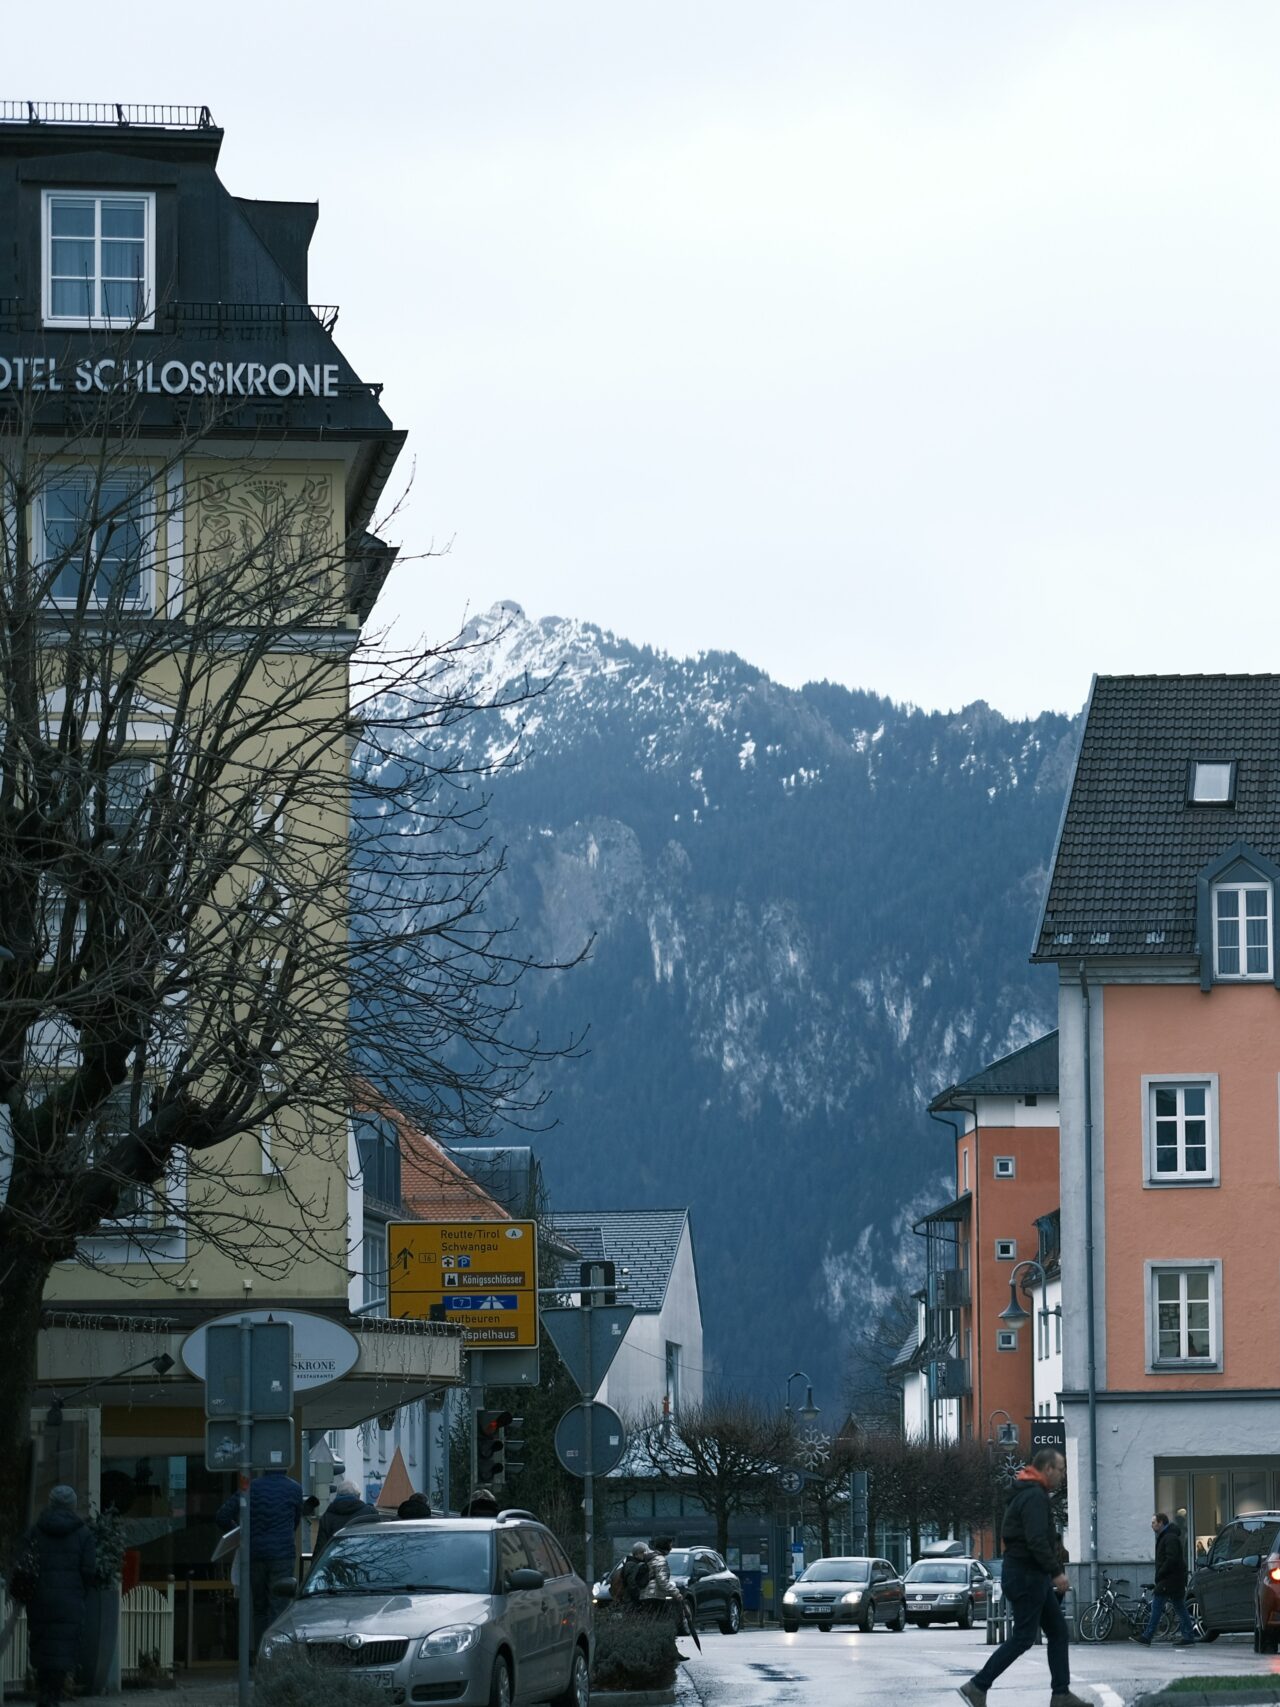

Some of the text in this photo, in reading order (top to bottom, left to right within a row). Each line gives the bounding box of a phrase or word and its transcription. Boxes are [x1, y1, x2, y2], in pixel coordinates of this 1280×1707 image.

[75, 359, 339, 397] SCHLOSSKRONE
[441, 1229, 500, 1239] Reutte/Tirol
[441, 1242, 499, 1253] Schwangau
[462, 1274, 523, 1286] Königsschlösser
[446, 1314, 500, 1323] aufbeuren
[1034, 1435, 1063, 1444] CECIL
